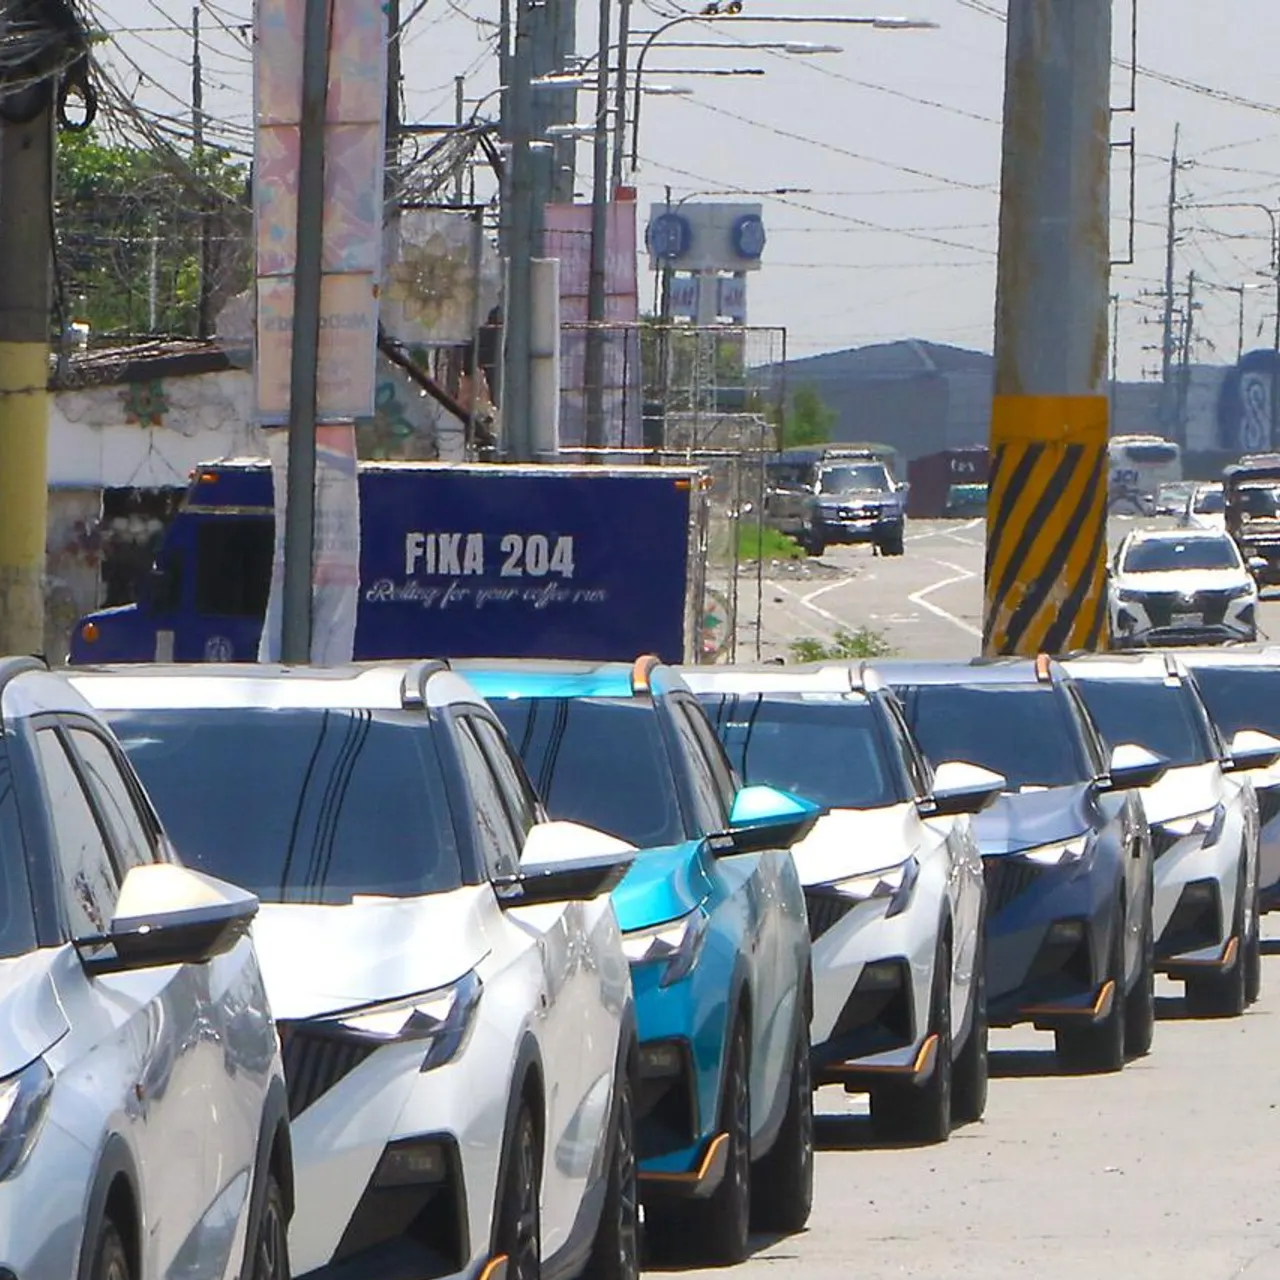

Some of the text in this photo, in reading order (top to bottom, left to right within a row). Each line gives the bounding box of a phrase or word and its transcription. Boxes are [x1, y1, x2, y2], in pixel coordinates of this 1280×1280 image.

[405, 533, 575, 578] FIKA 204
[366, 578, 440, 607] Rolling
[440, 579, 470, 609] for
[476, 589, 519, 608] your
[523, 580, 569, 610] coffee
